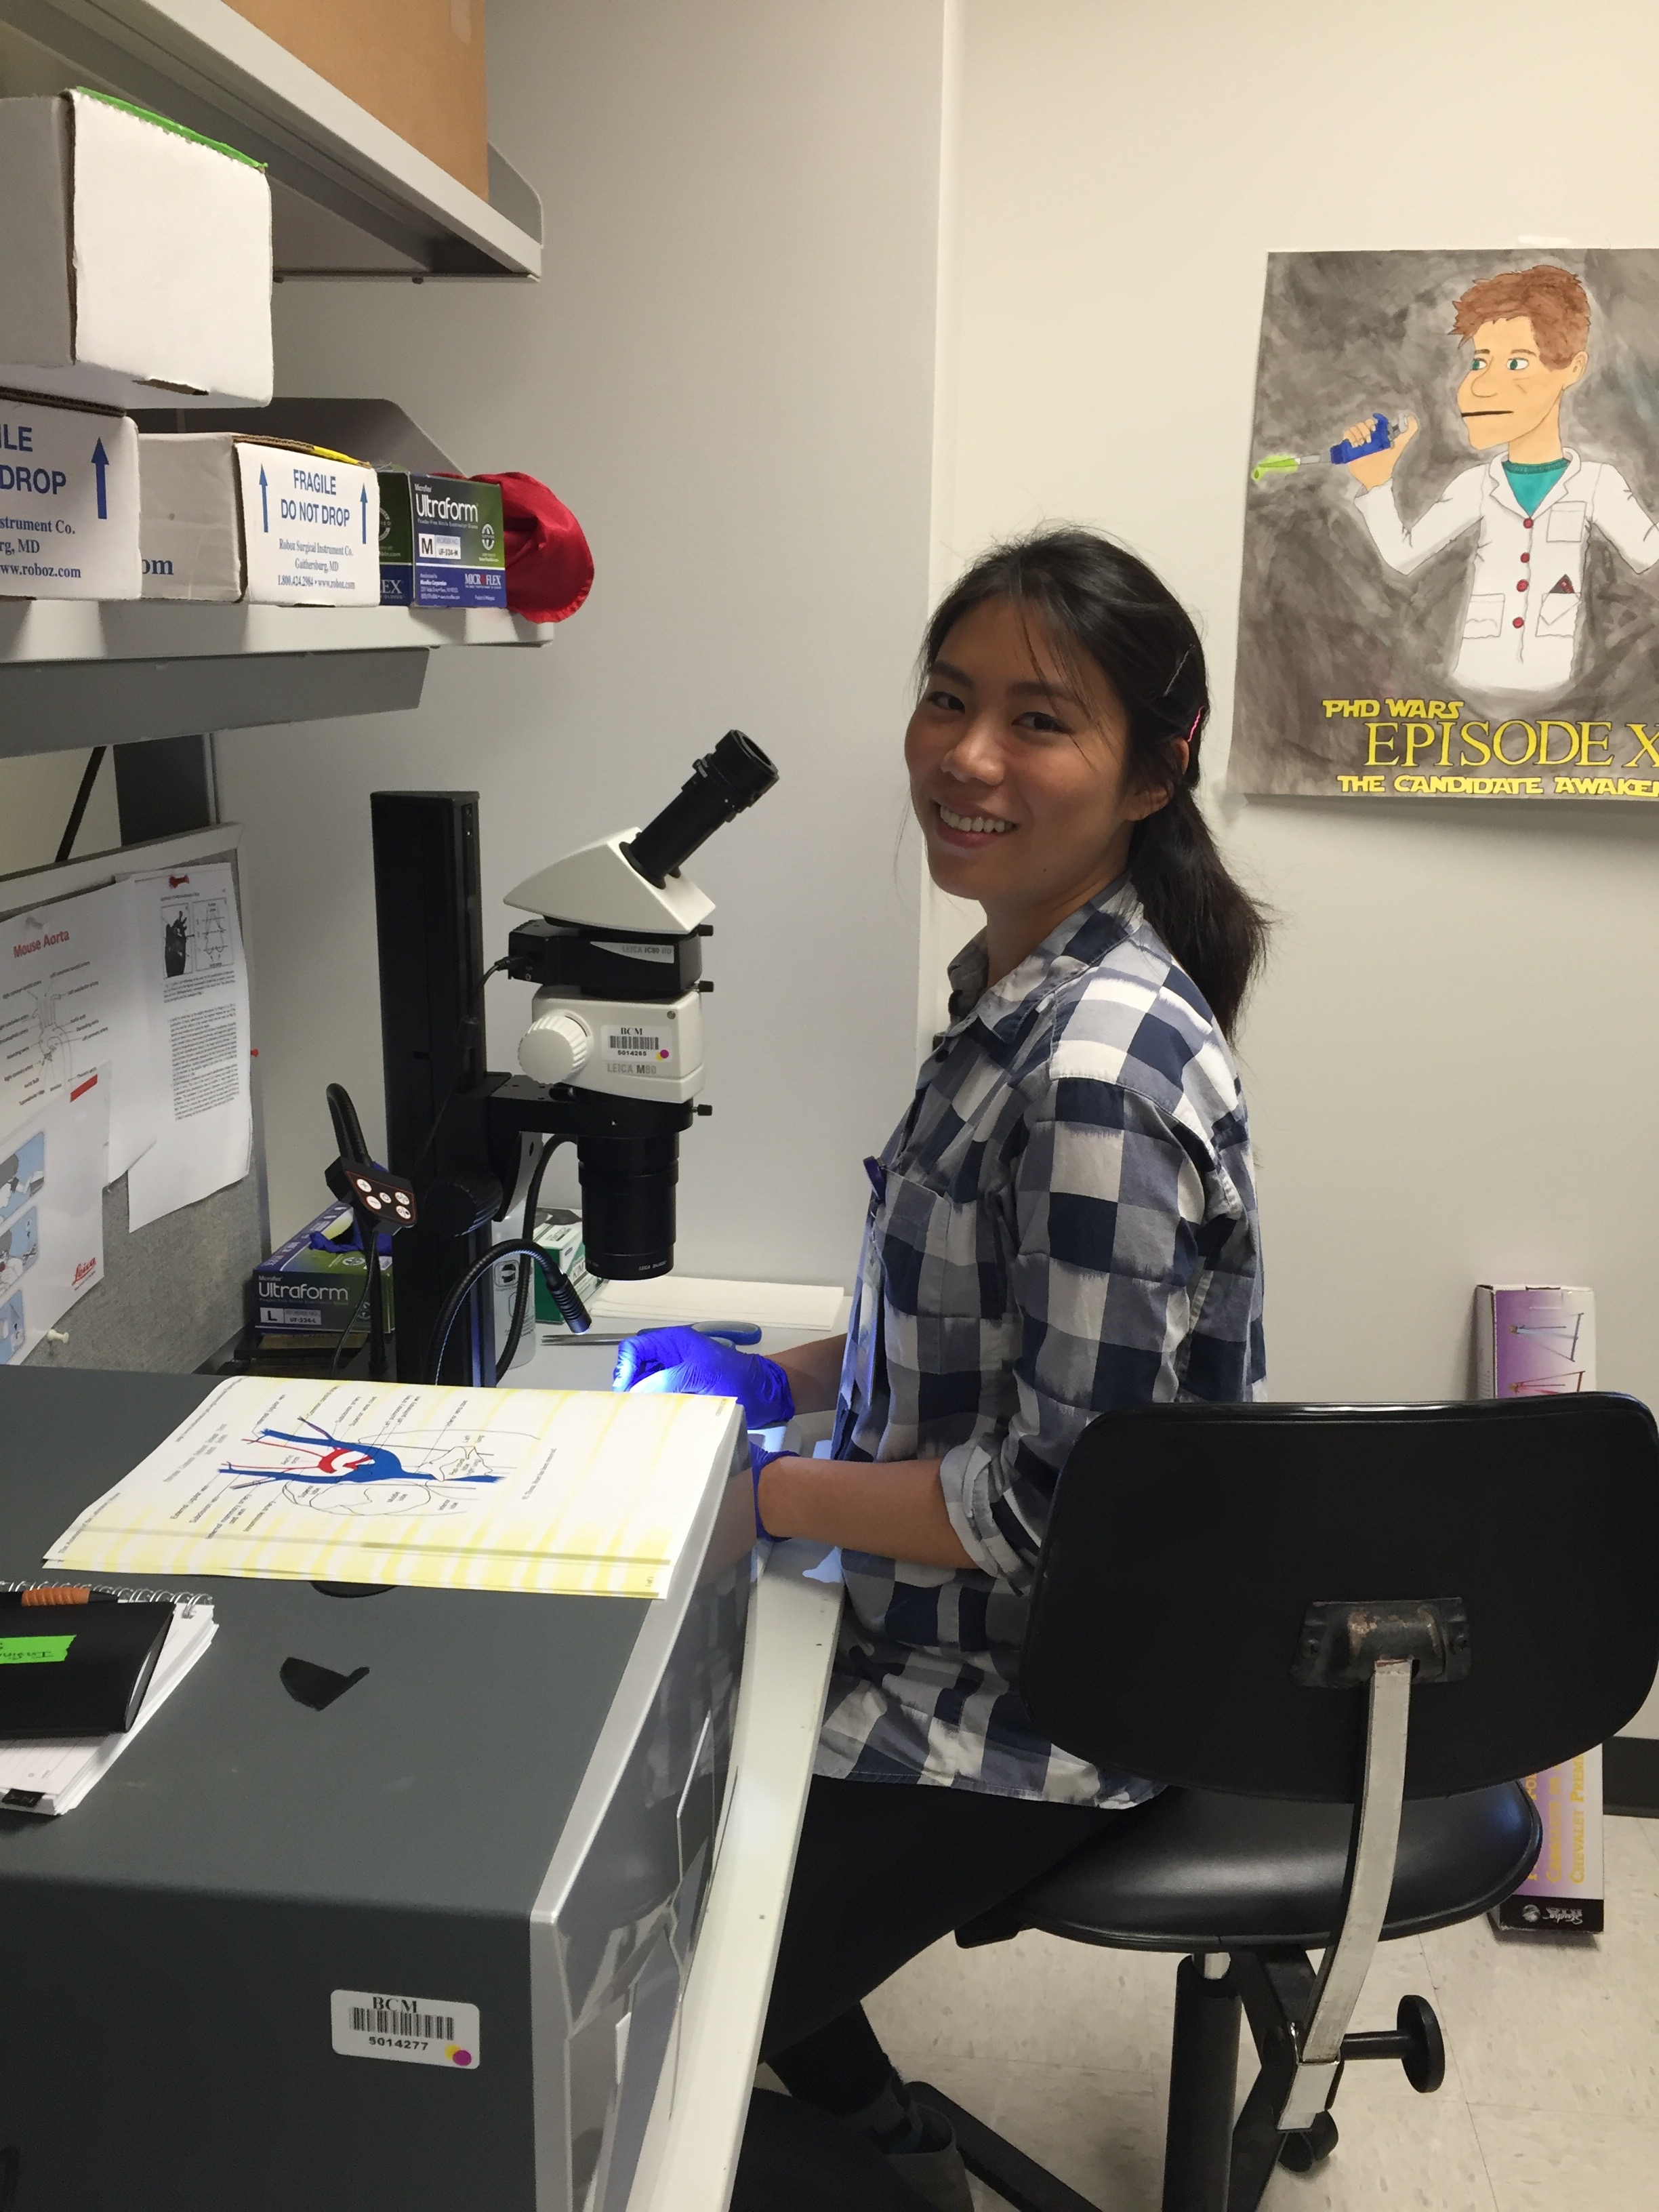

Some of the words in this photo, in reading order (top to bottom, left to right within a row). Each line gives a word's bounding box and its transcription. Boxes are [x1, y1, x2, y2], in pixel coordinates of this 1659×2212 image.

[0, 465, 66, 495] DROP
[293, 469, 336, 495] FRAGILE
[281, 499, 296, 520] DO
[299, 501, 319, 523] NOT
[322, 505, 350, 527] DROP
[415, 493, 478, 523] Ultraform
[56, 520, 75, 534] Co.
[18, 538, 40, 553] MD
[344, 546, 353, 556] Co.
[422, 538, 433, 554] M
[329, 560, 338, 571] MD
[1322, 699, 1380, 718] PHD
[1385, 698, 1465, 719] WARS
[1363, 719, 1614, 768] EPISODE
[1336, 775, 1386, 793] THE
[1393, 775, 1544, 794] CANDIDATE
[13, 940, 41, 958] Mouse
[43, 930, 70, 947] Aorta
[621, 1027, 642, 1036] BCM
[607, 1063, 634, 1073] LEICA
[636, 1065, 657, 1074] M80
[72, 1257, 96, 1286] Leica
[259, 1282, 348, 1300] Ultraform
[268, 1310, 277, 1322] L
[1570, 1809, 1584, 1884] CHEVALET
[373, 1996, 417, 2013] BCM
[369, 2036, 428, 2051] 5014277
